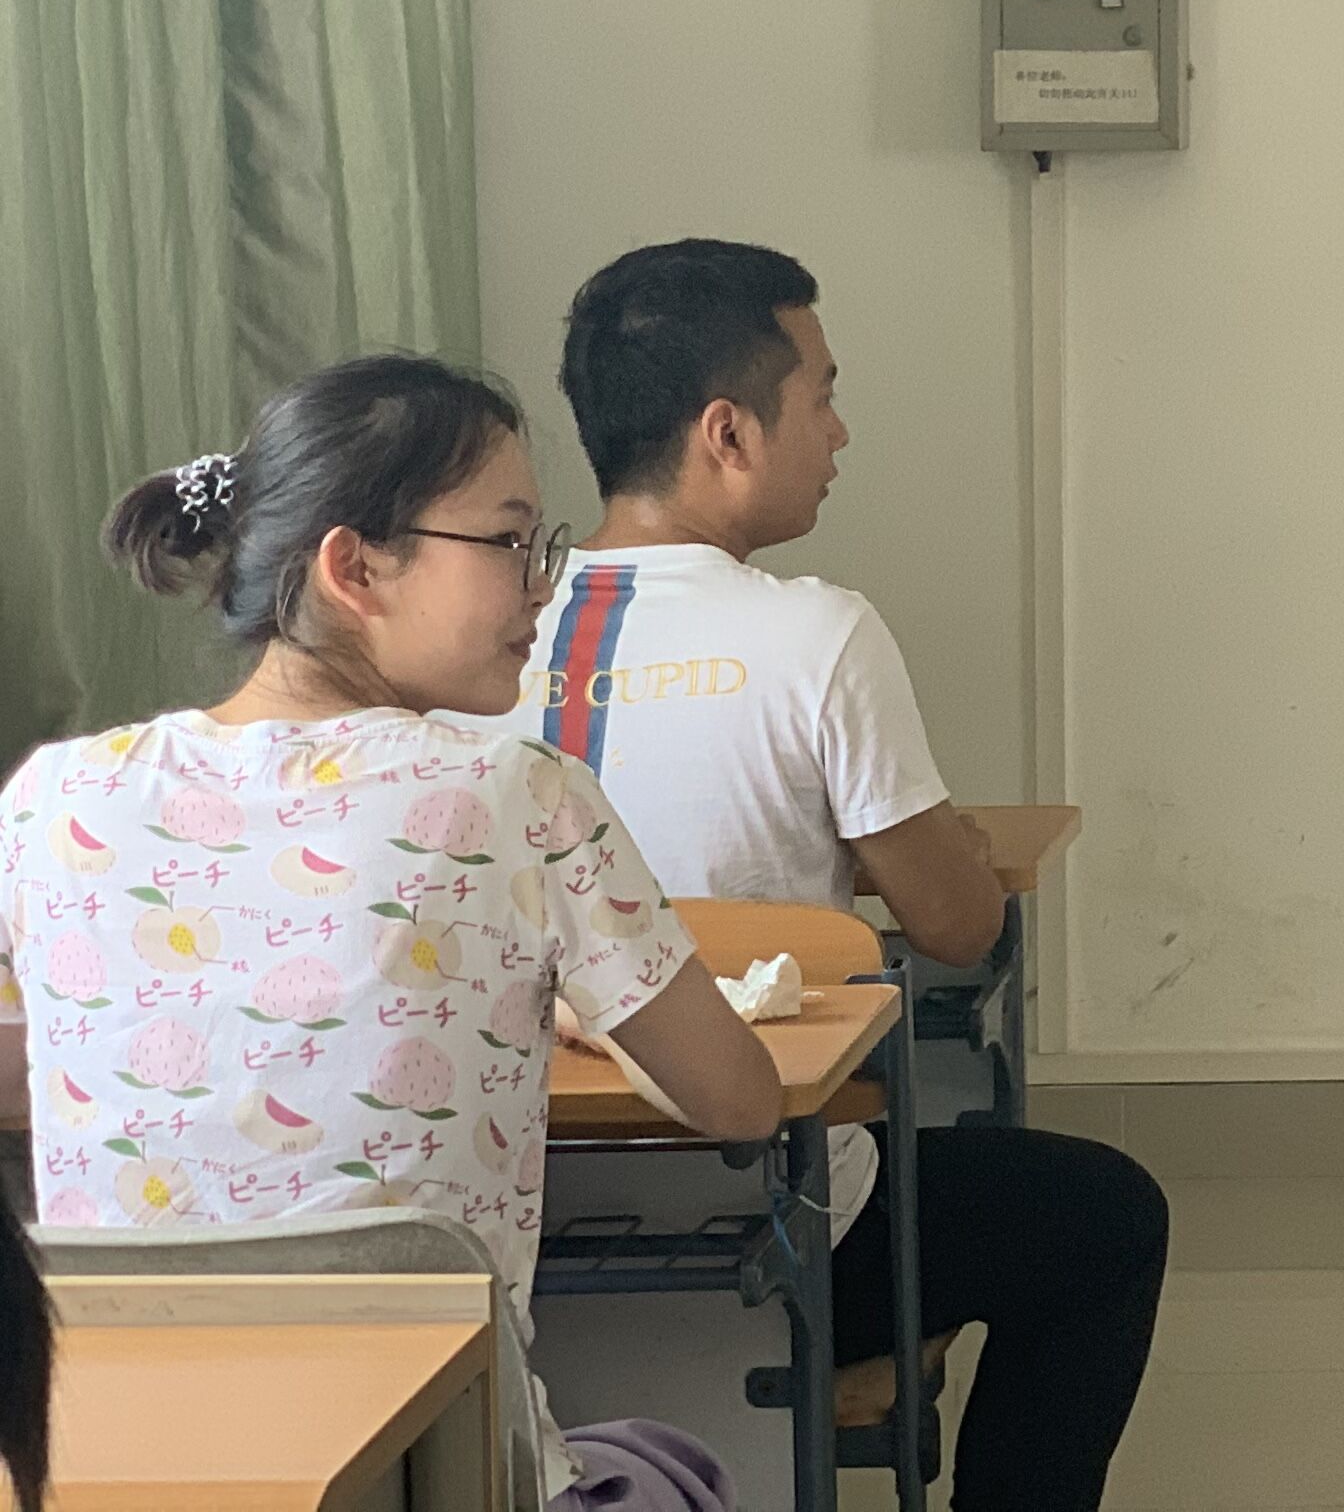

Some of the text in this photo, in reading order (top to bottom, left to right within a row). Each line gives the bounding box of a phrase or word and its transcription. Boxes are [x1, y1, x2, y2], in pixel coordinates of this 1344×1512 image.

[584, 657, 747, 707] CUPID
[61, 769, 127, 797] ピーチ
[178, 759, 249, 790] ピーチ
[412, 756, 497, 780] ピーチ
[277, 793, 360, 828] ピーチ
[152, 859, 231, 889] ピーチ
[396, 873, 478, 903] ピーチ
[46, 891, 106, 920] ピーチ
[265, 912, 343, 948] ピーチ
[136, 978, 213, 1007] ピーチ
[379, 997, 458, 1029] ピーチ
[47, 1014, 96, 1046] ピーチ
[244, 1035, 326, 1070] ピーチ
[480, 1063, 526, 1094] ピーチ
[123, 1108, 194, 1139] ピーチ
[46, 1145, 92, 1176] ピーチ
[363, 1129, 445, 1161] ピーチ
[229, 1170, 313, 1204] ピーチ
[462, 1192, 508, 1225] ピーチ
